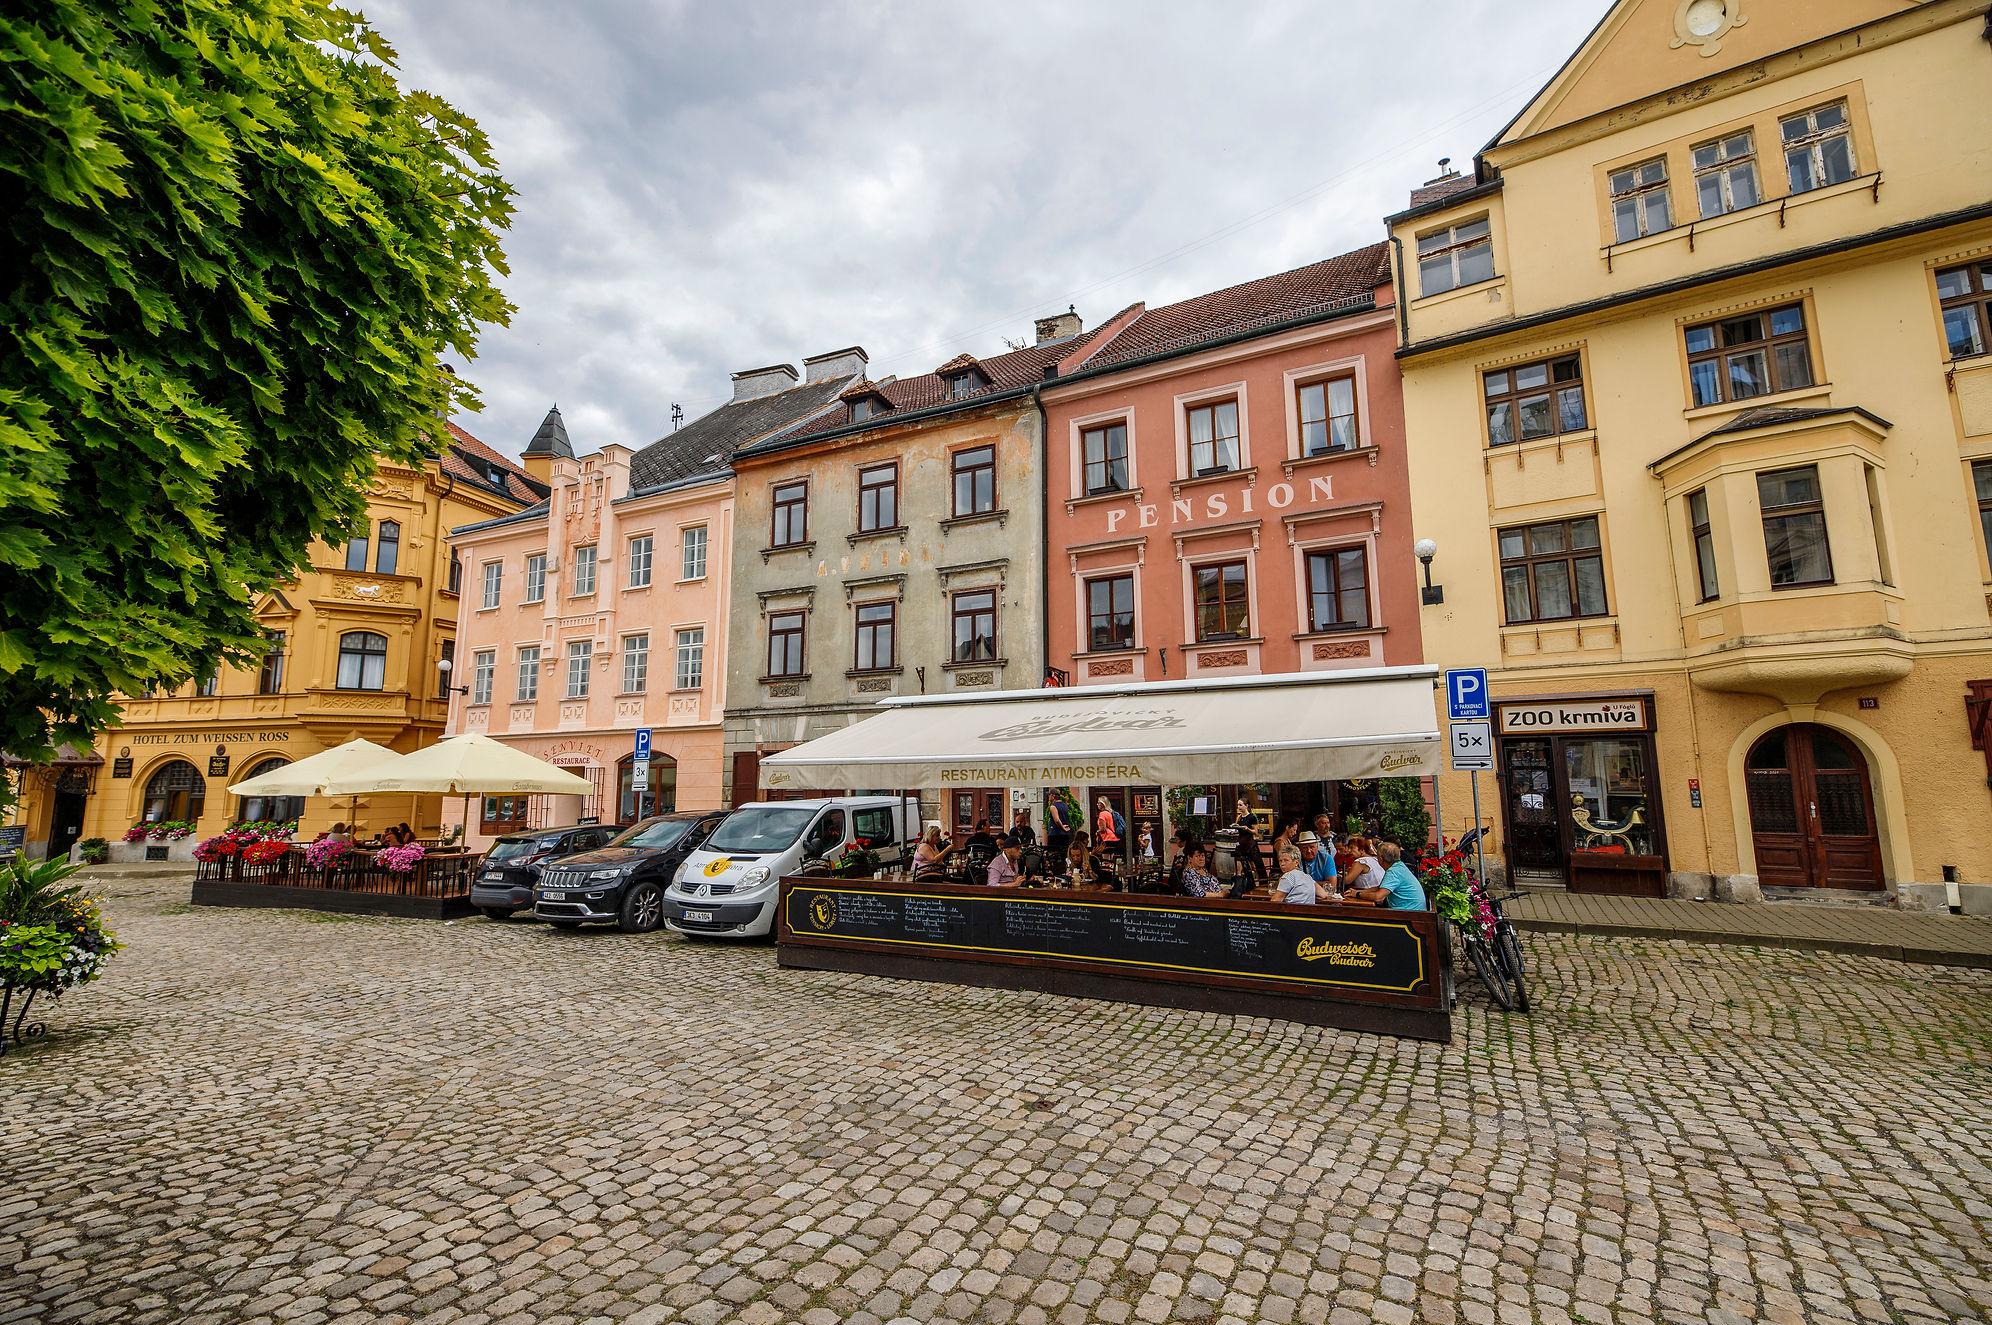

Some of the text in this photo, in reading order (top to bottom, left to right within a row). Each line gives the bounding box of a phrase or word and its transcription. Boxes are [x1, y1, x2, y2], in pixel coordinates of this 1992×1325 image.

[1106, 475, 1334, 533] PENSION
[1456, 675, 1479, 704] P
[1862, 699, 1875, 708] 113
[1508, 708, 1636, 726] ZOO krmiva
[977, 715, 1188, 741] Budvar
[133, 731, 290, 745] HOTEL ZUM WEISSEN ROSS
[638, 732, 649, 750] P
[543, 740, 603, 759] SENVIET
[552, 756, 591, 765] RESTAURACE
[1380, 754, 1423, 771] Budvar
[941, 762, 1142, 782] RESTAURANT ATMOSFÉRA
[1296, 936, 1377, 961] Budweiser
[1329, 953, 1375, 968] Budvar
